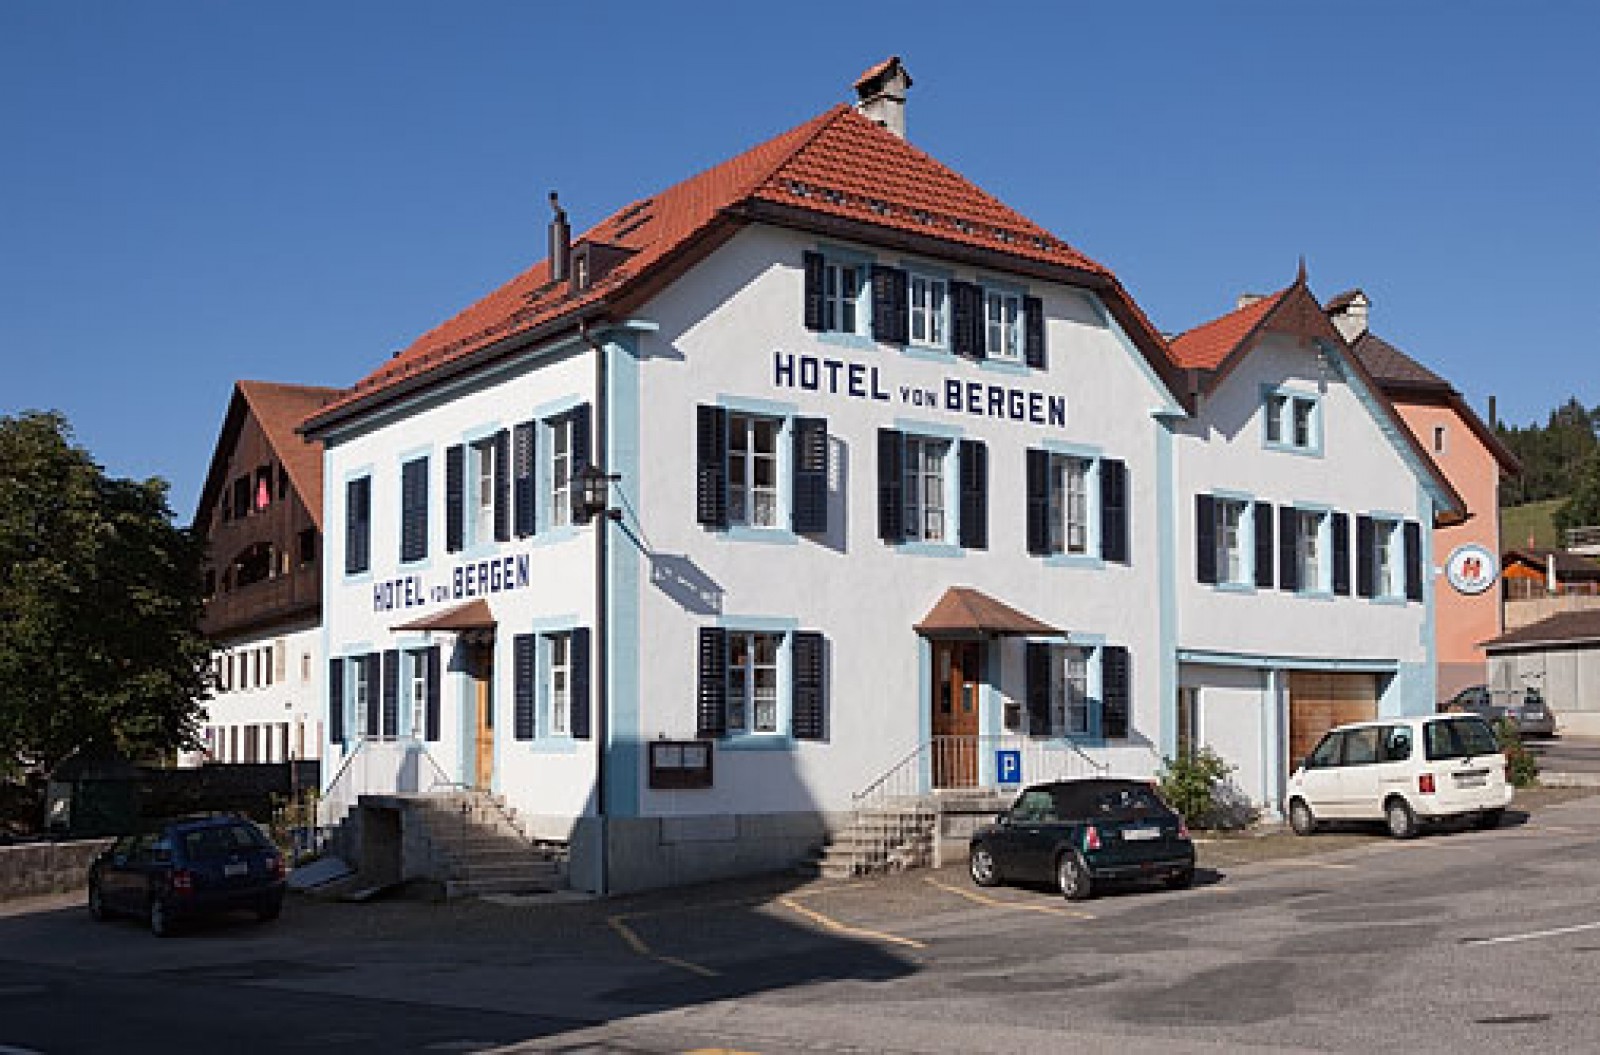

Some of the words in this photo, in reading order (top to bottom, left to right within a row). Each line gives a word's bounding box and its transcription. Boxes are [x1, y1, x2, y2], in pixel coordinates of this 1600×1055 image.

[774, 351, 890, 400] HOTEL
[945, 378, 1066, 427] BERGEN
[373, 576, 425, 612] HOTEL
[453, 553, 530, 599] BERGEN
[1003, 754, 1015, 780] P
